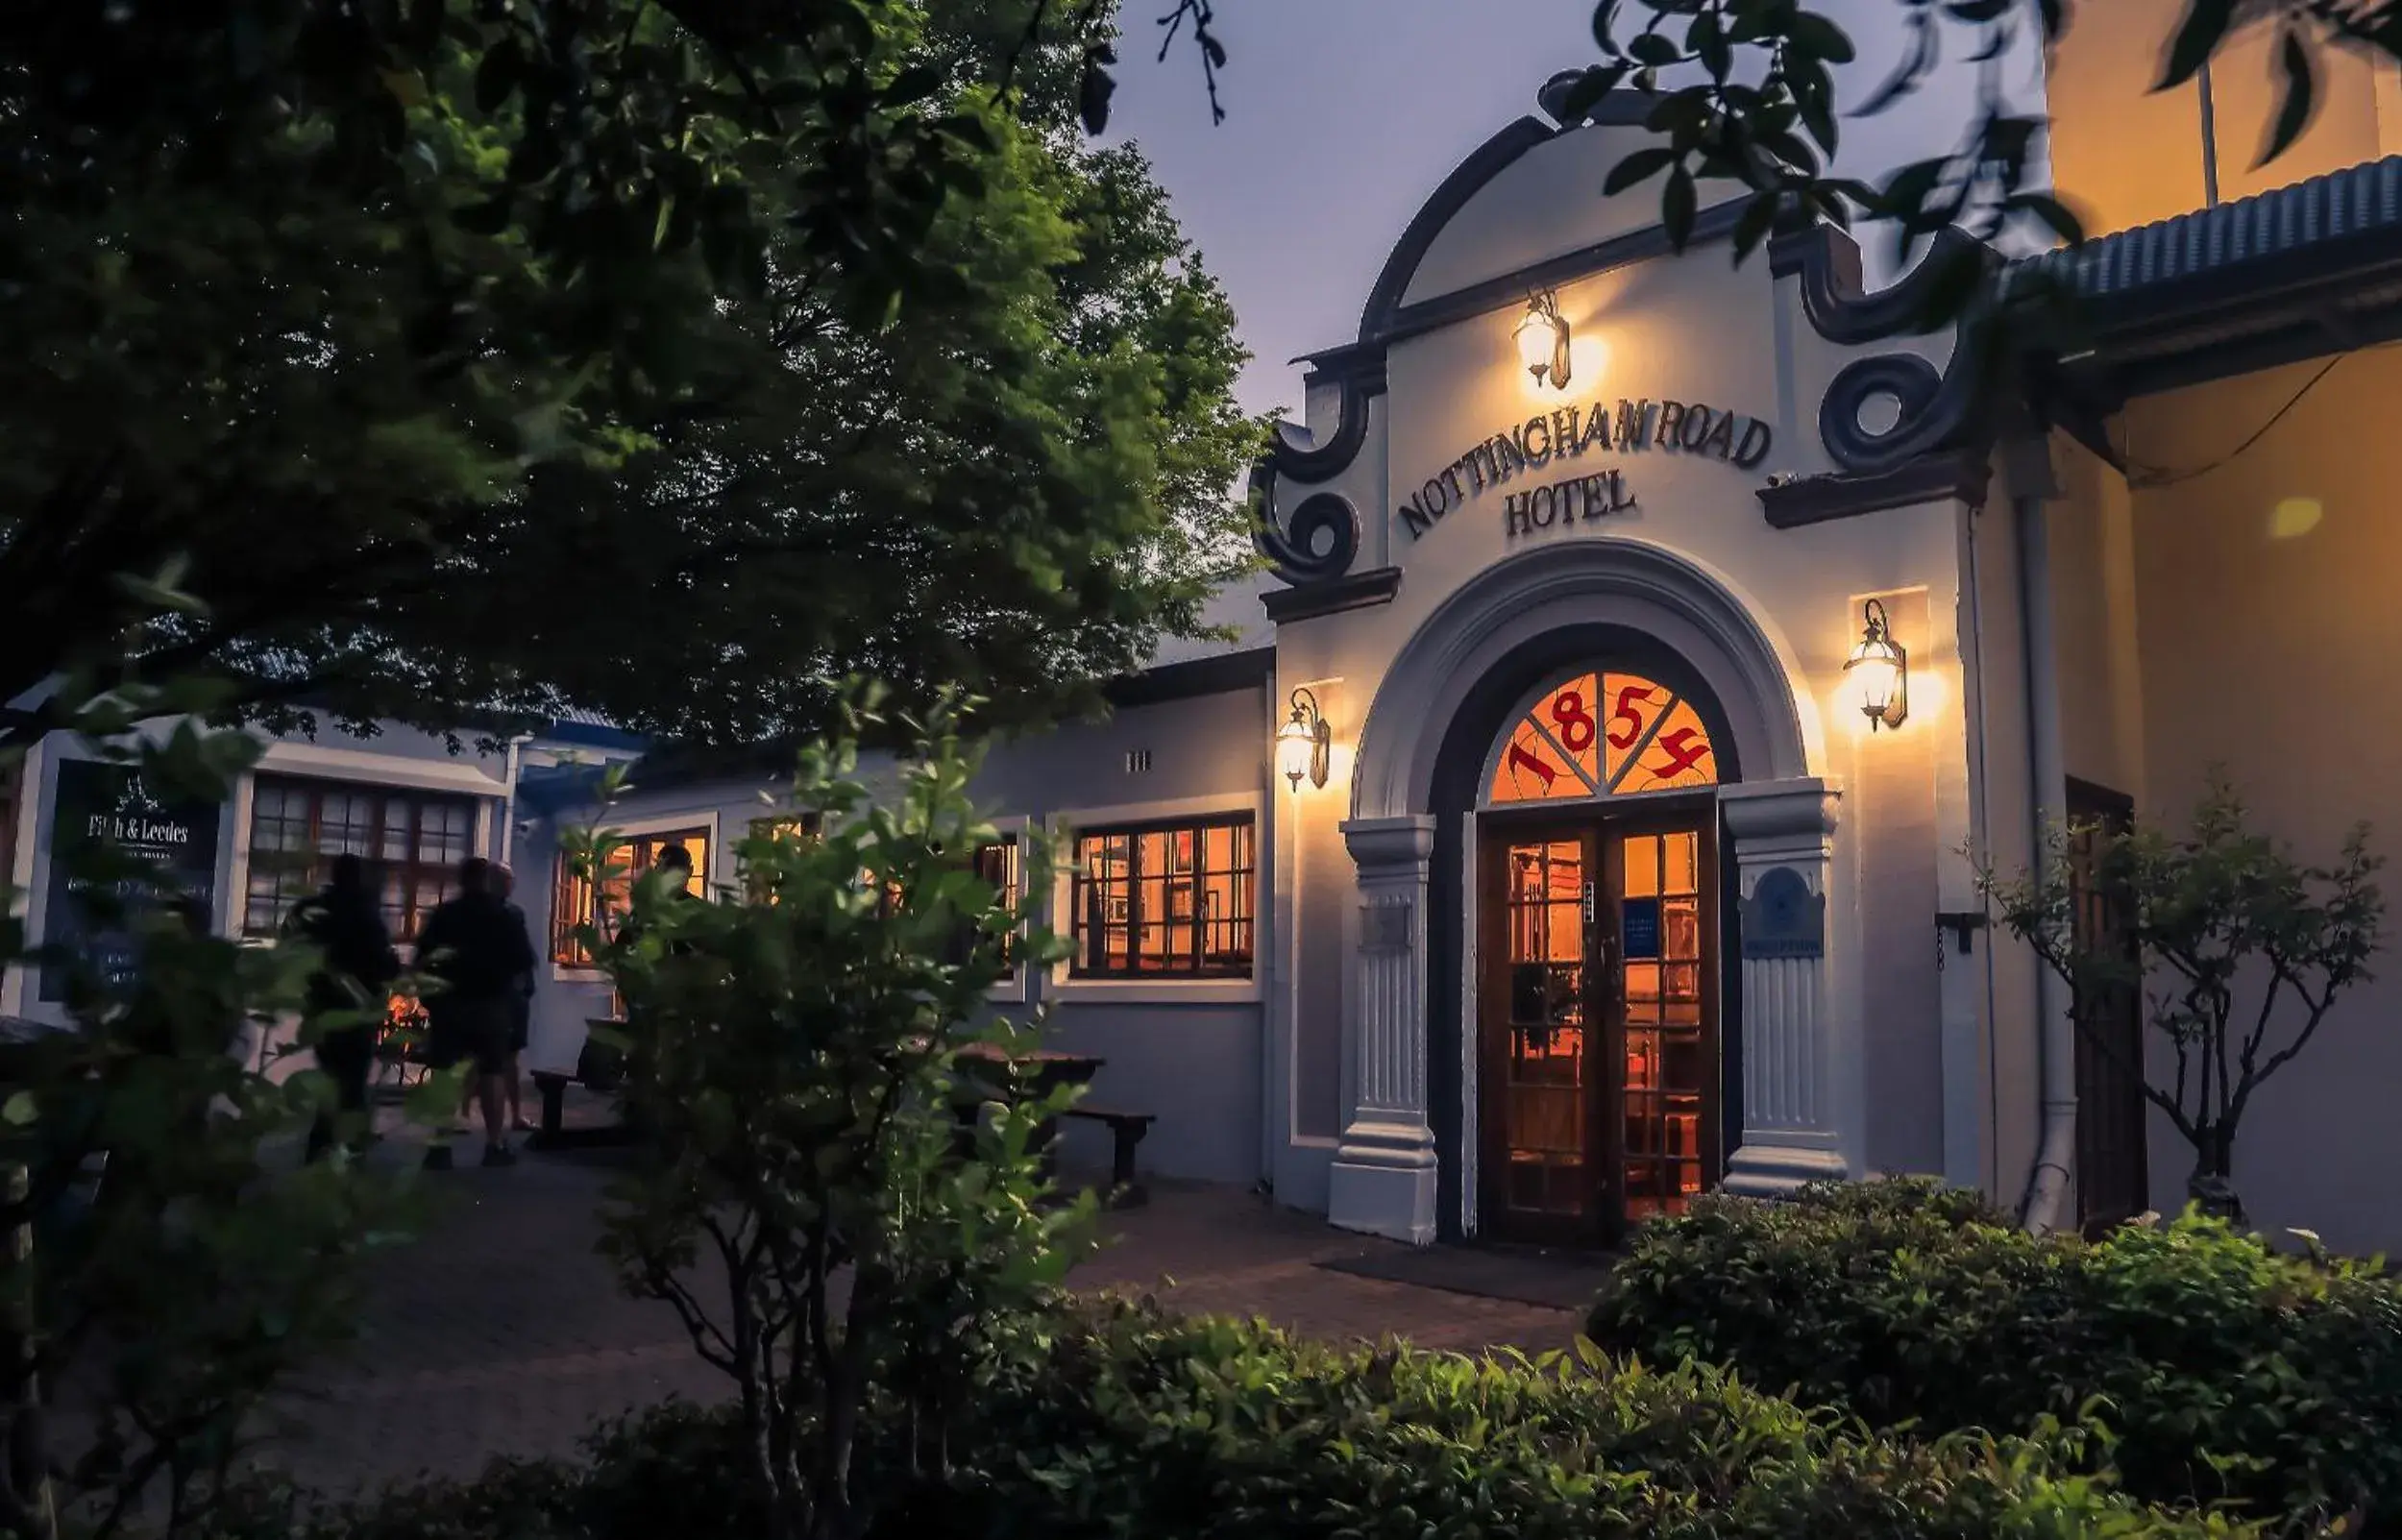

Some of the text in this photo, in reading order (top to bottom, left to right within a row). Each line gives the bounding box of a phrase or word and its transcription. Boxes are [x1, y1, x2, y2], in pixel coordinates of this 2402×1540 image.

[1398, 399, 1772, 540] NOTTINGHAM ROAD
[1505, 469, 1637, 537] HOTEL
[1508, 687, 1710, 787] 1854
[88, 815, 188, 843] Fih & Leedes
